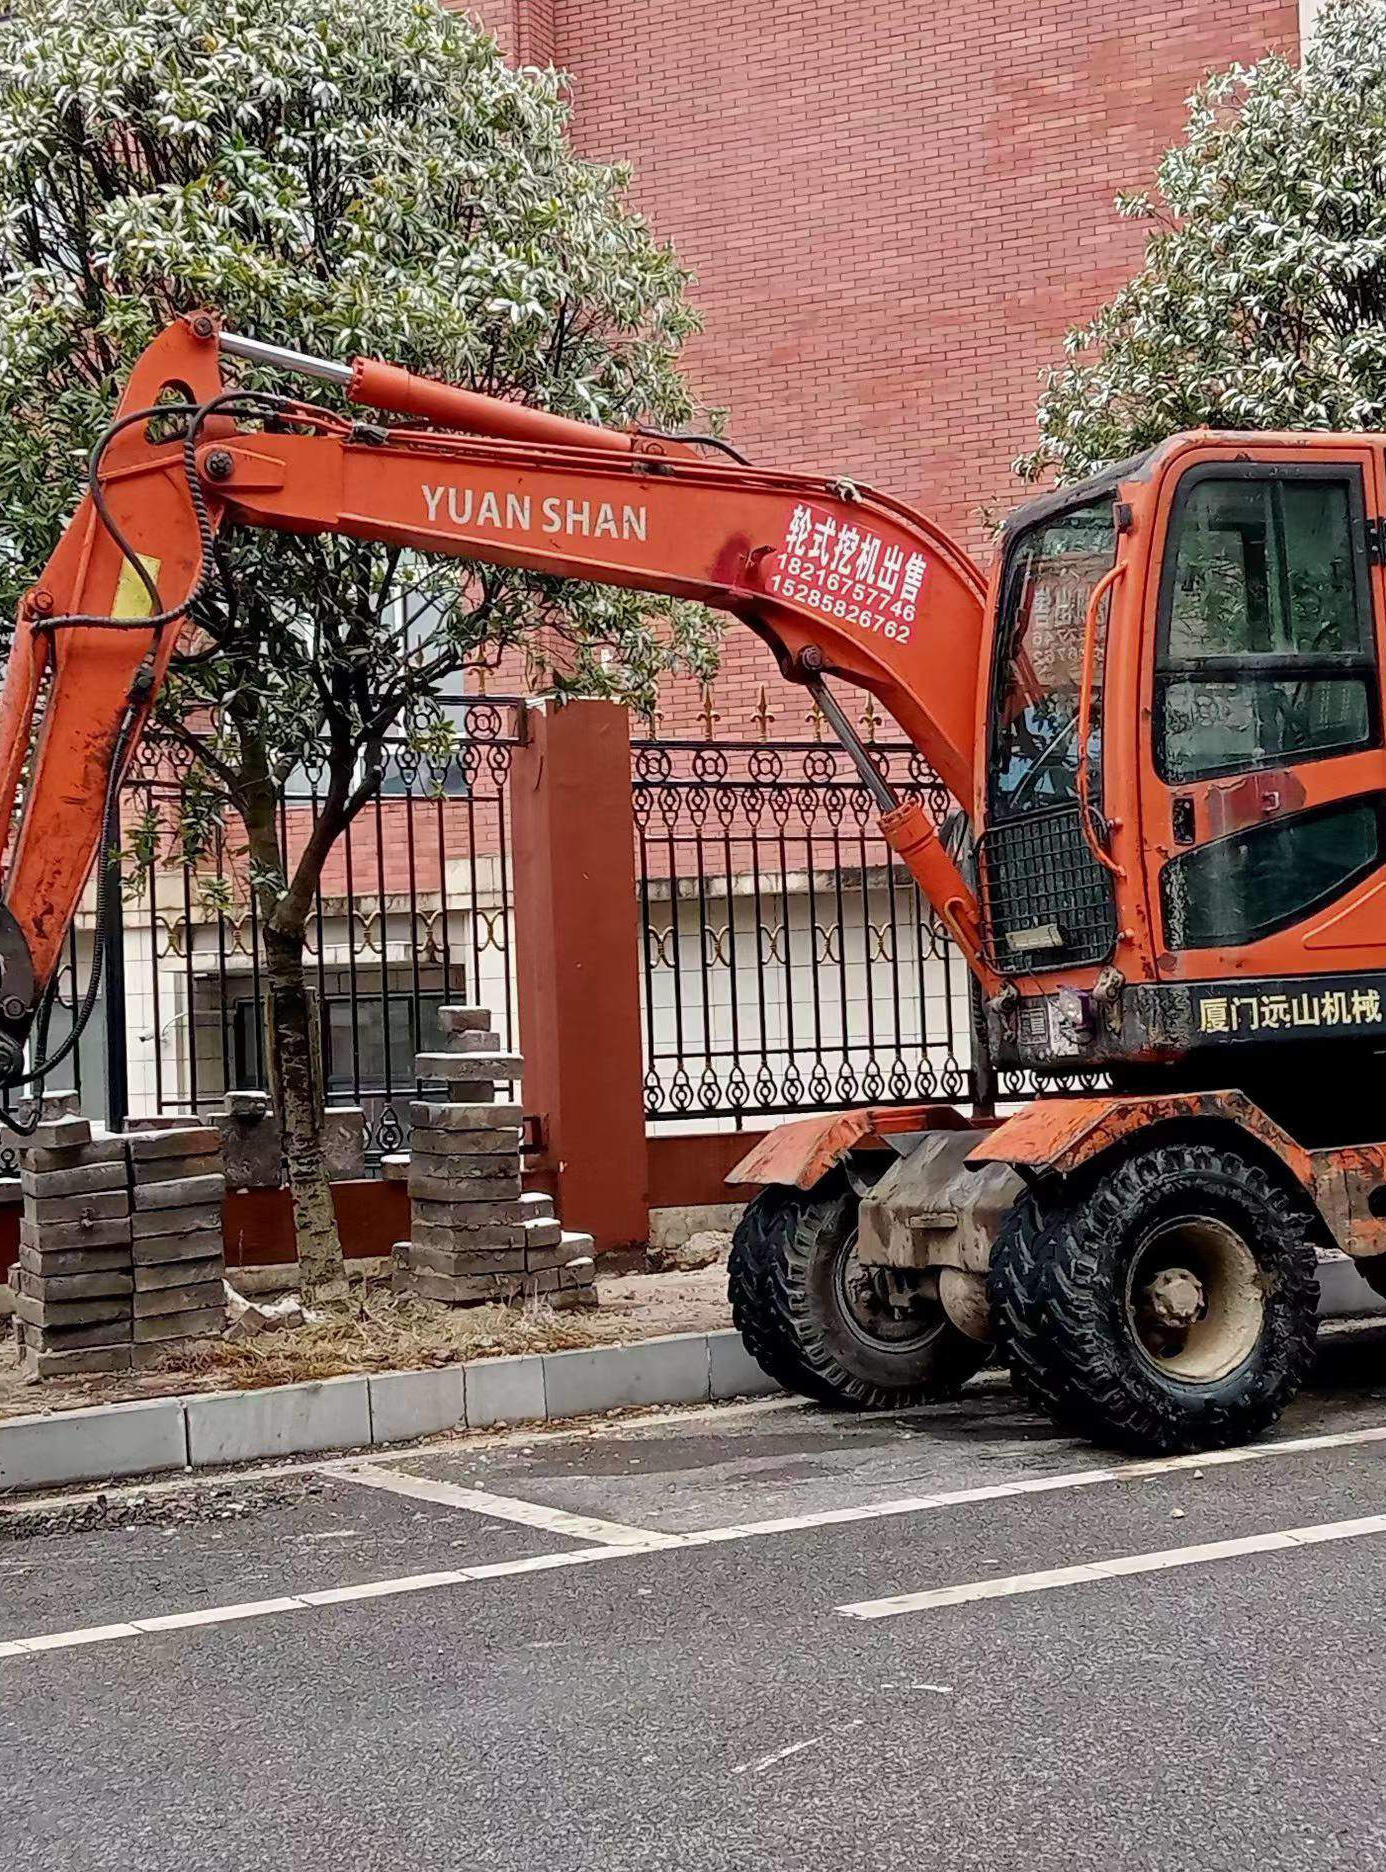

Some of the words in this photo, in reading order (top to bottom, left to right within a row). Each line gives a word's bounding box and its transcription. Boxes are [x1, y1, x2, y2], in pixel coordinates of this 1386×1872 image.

[421, 484, 531, 531] YUAN
[541, 496, 647, 541] SHAN
[777, 552, 916, 622] 18216757746
[784, 503, 927, 604] 轮式挖机出售
[770, 574, 912, 644] 15285826762
[1197, 989, 1383, 1034] 厦门远山机械
